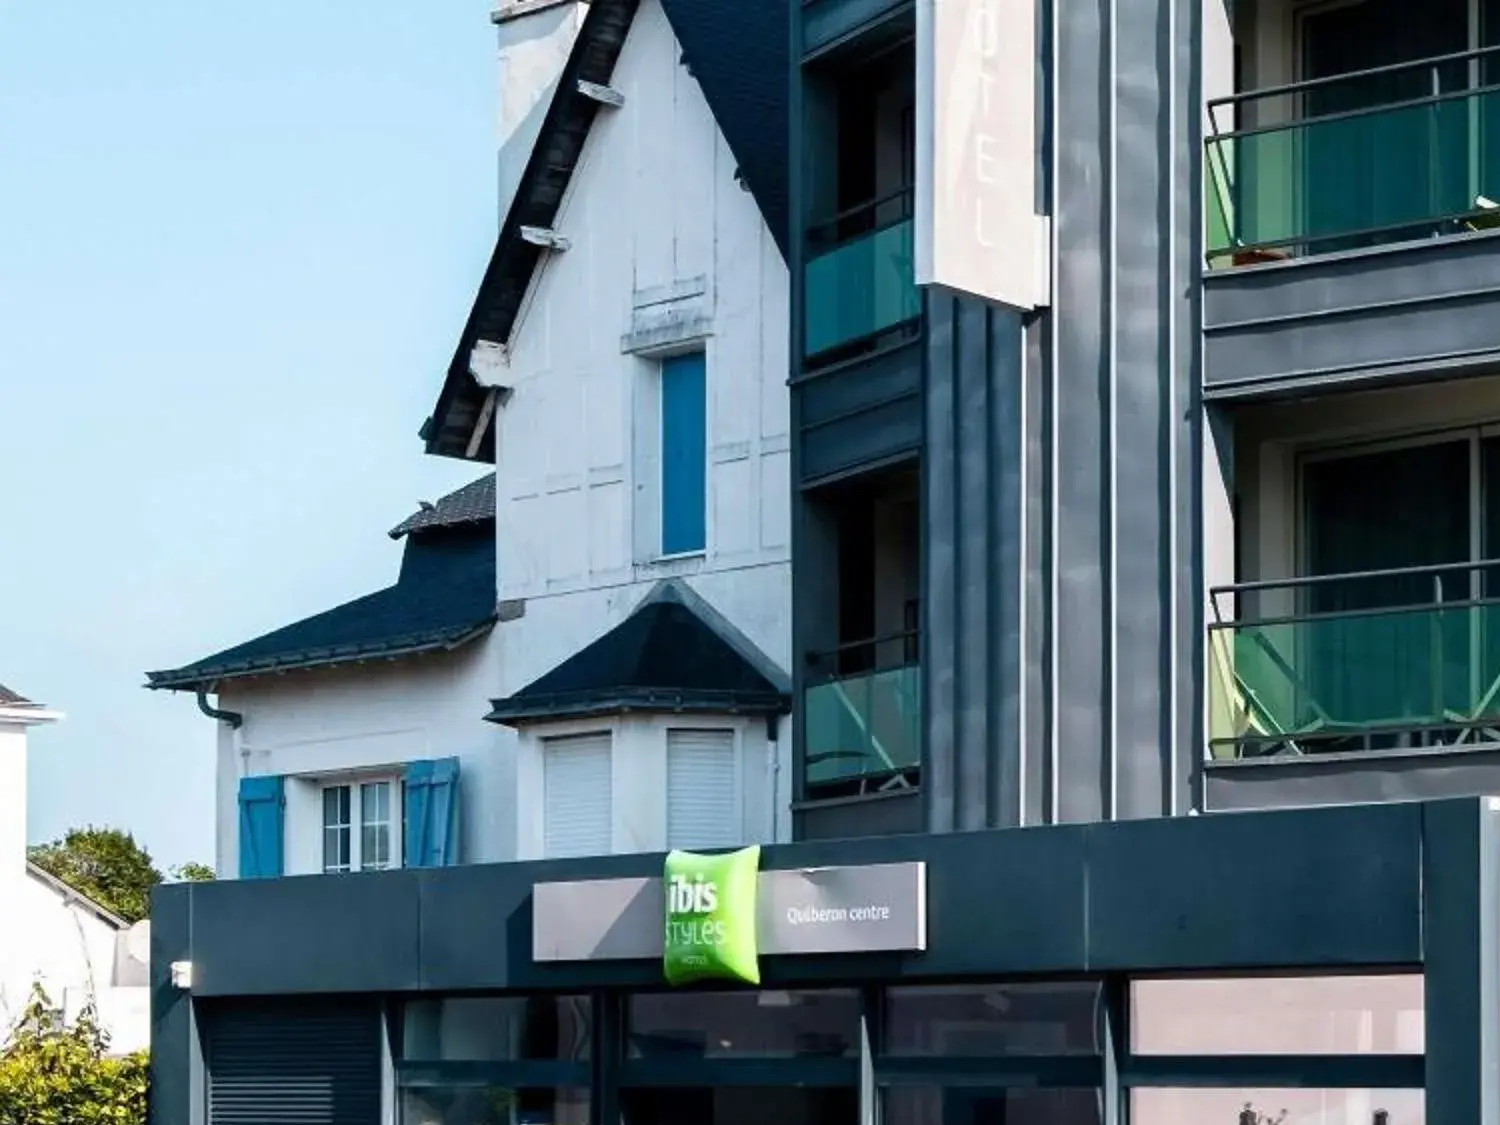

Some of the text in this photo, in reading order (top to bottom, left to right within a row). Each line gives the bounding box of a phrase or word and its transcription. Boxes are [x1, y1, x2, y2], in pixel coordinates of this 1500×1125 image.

[974, 8, 998, 247] OTEL
[670, 873, 718, 912] ibis
[786, 903, 890, 925] Quiberon centre
